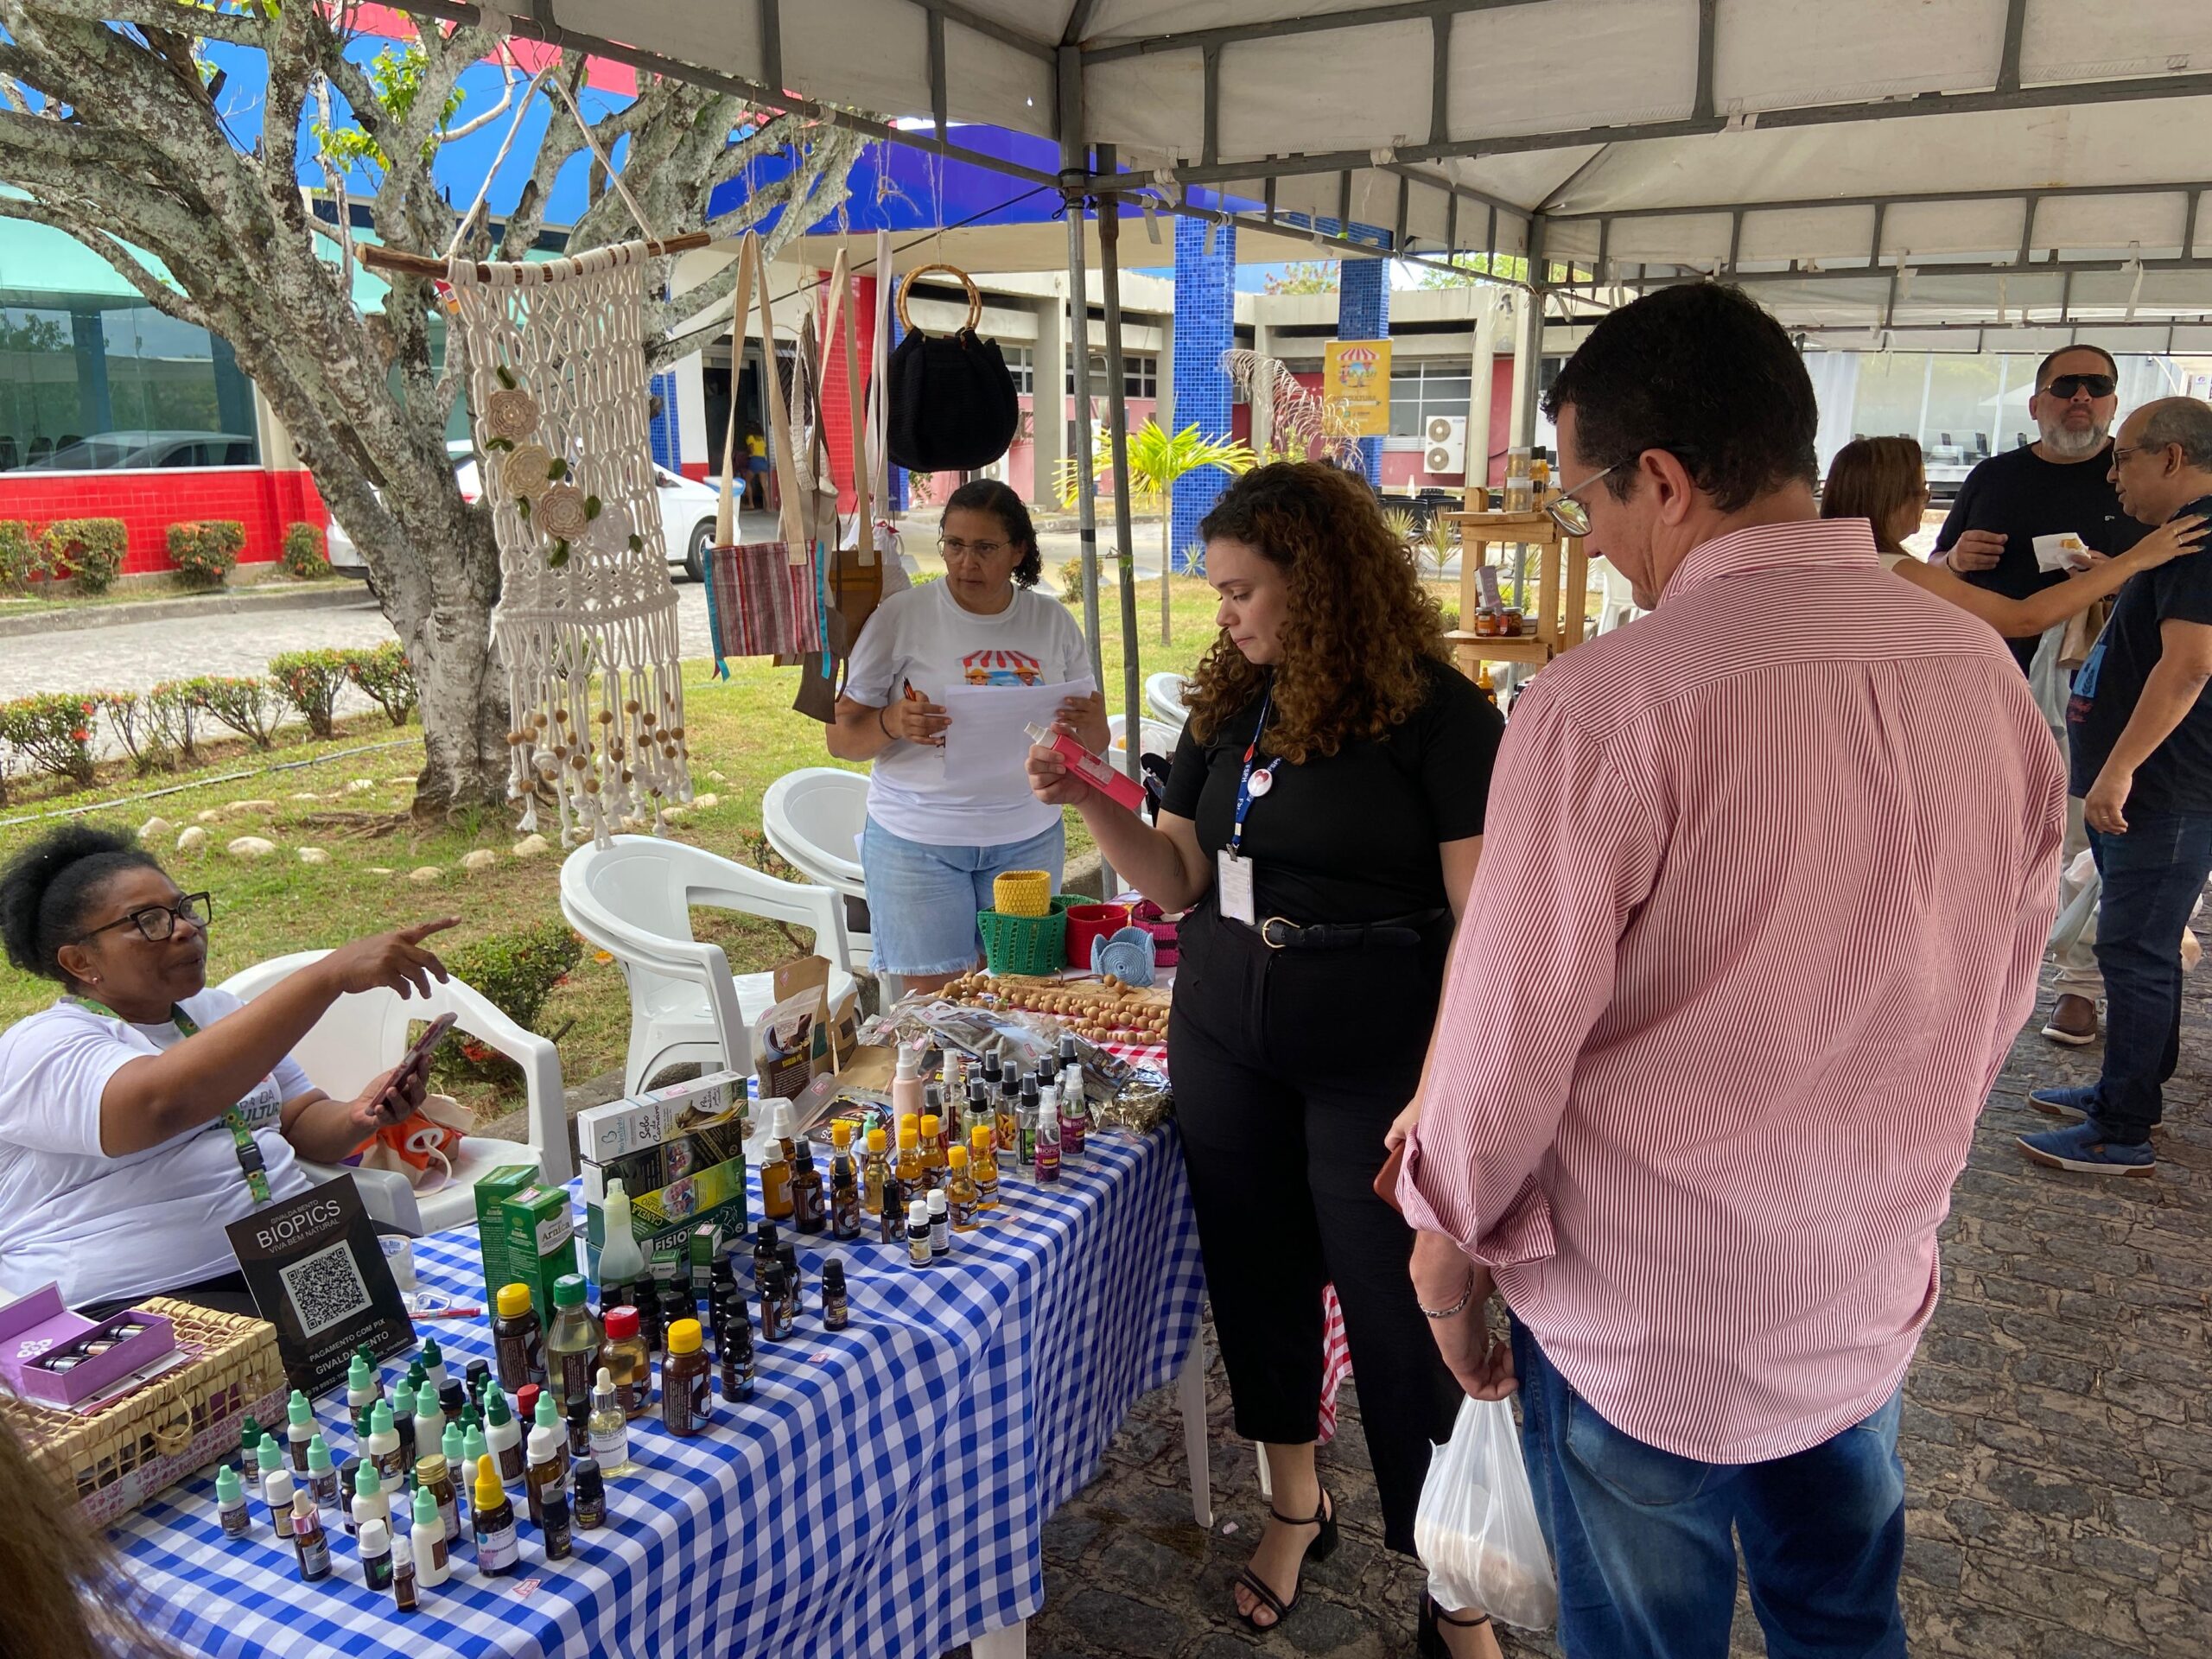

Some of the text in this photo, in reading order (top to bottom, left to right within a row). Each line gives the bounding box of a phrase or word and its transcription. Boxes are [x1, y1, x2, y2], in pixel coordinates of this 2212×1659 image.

[1242, 764, 1250, 783] FSPH
[260, 1089, 275, 1104] DA
[639, 1115, 651, 1140] Sebo
[257, 1199, 340, 1249] BIOPICS
[270, 1199, 319, 1224] GIVALDA BENTO
[632, 1204, 664, 1226] CANELA
[269, 1218, 340, 1254] VIVA BEM NATURAL
[542, 1221, 570, 1243] Arnica
[309, 1318, 386, 1362] PAGAMENTO COM PIX
[315, 1331, 389, 1375] GIVALDA ENTO
